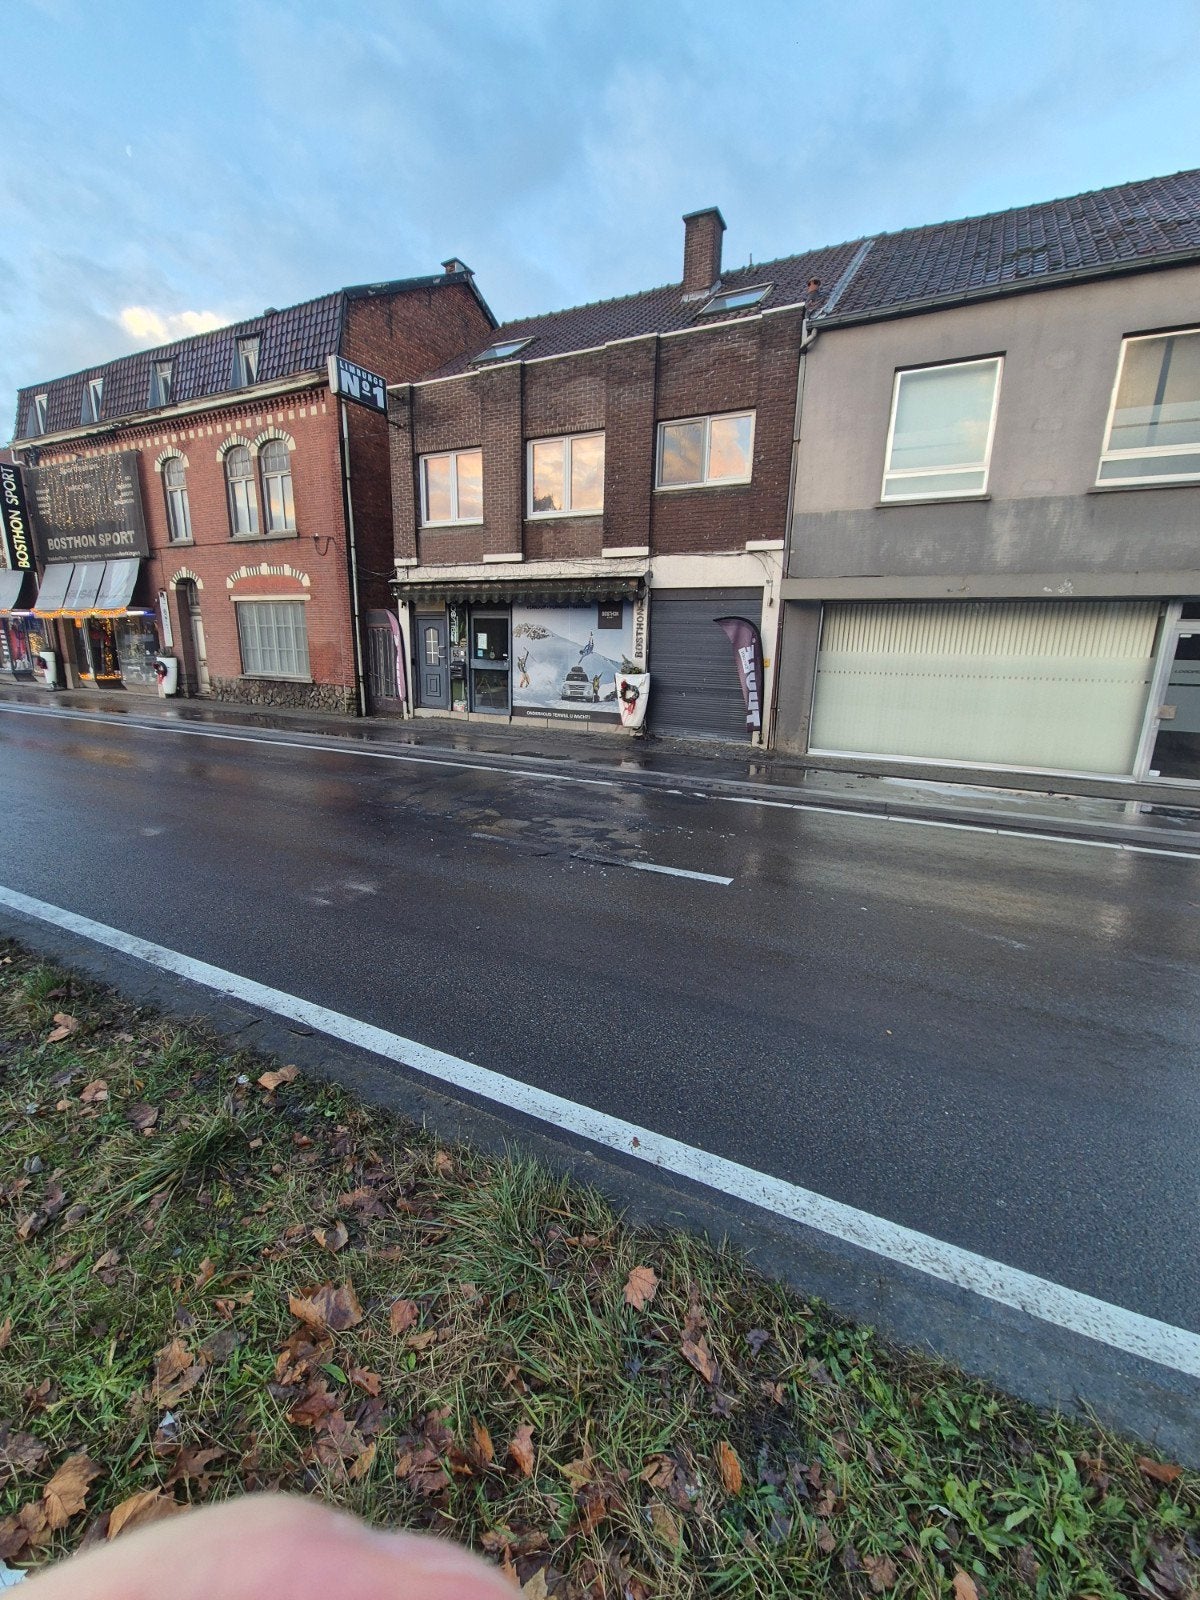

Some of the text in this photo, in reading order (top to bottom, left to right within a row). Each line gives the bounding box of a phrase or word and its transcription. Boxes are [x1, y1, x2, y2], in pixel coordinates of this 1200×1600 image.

[1, 465, 31, 568] BOSTHON SPORT
[47, 530, 135, 551] BOSTHON SPORT
[635, 606, 645, 658] BOSTHON
